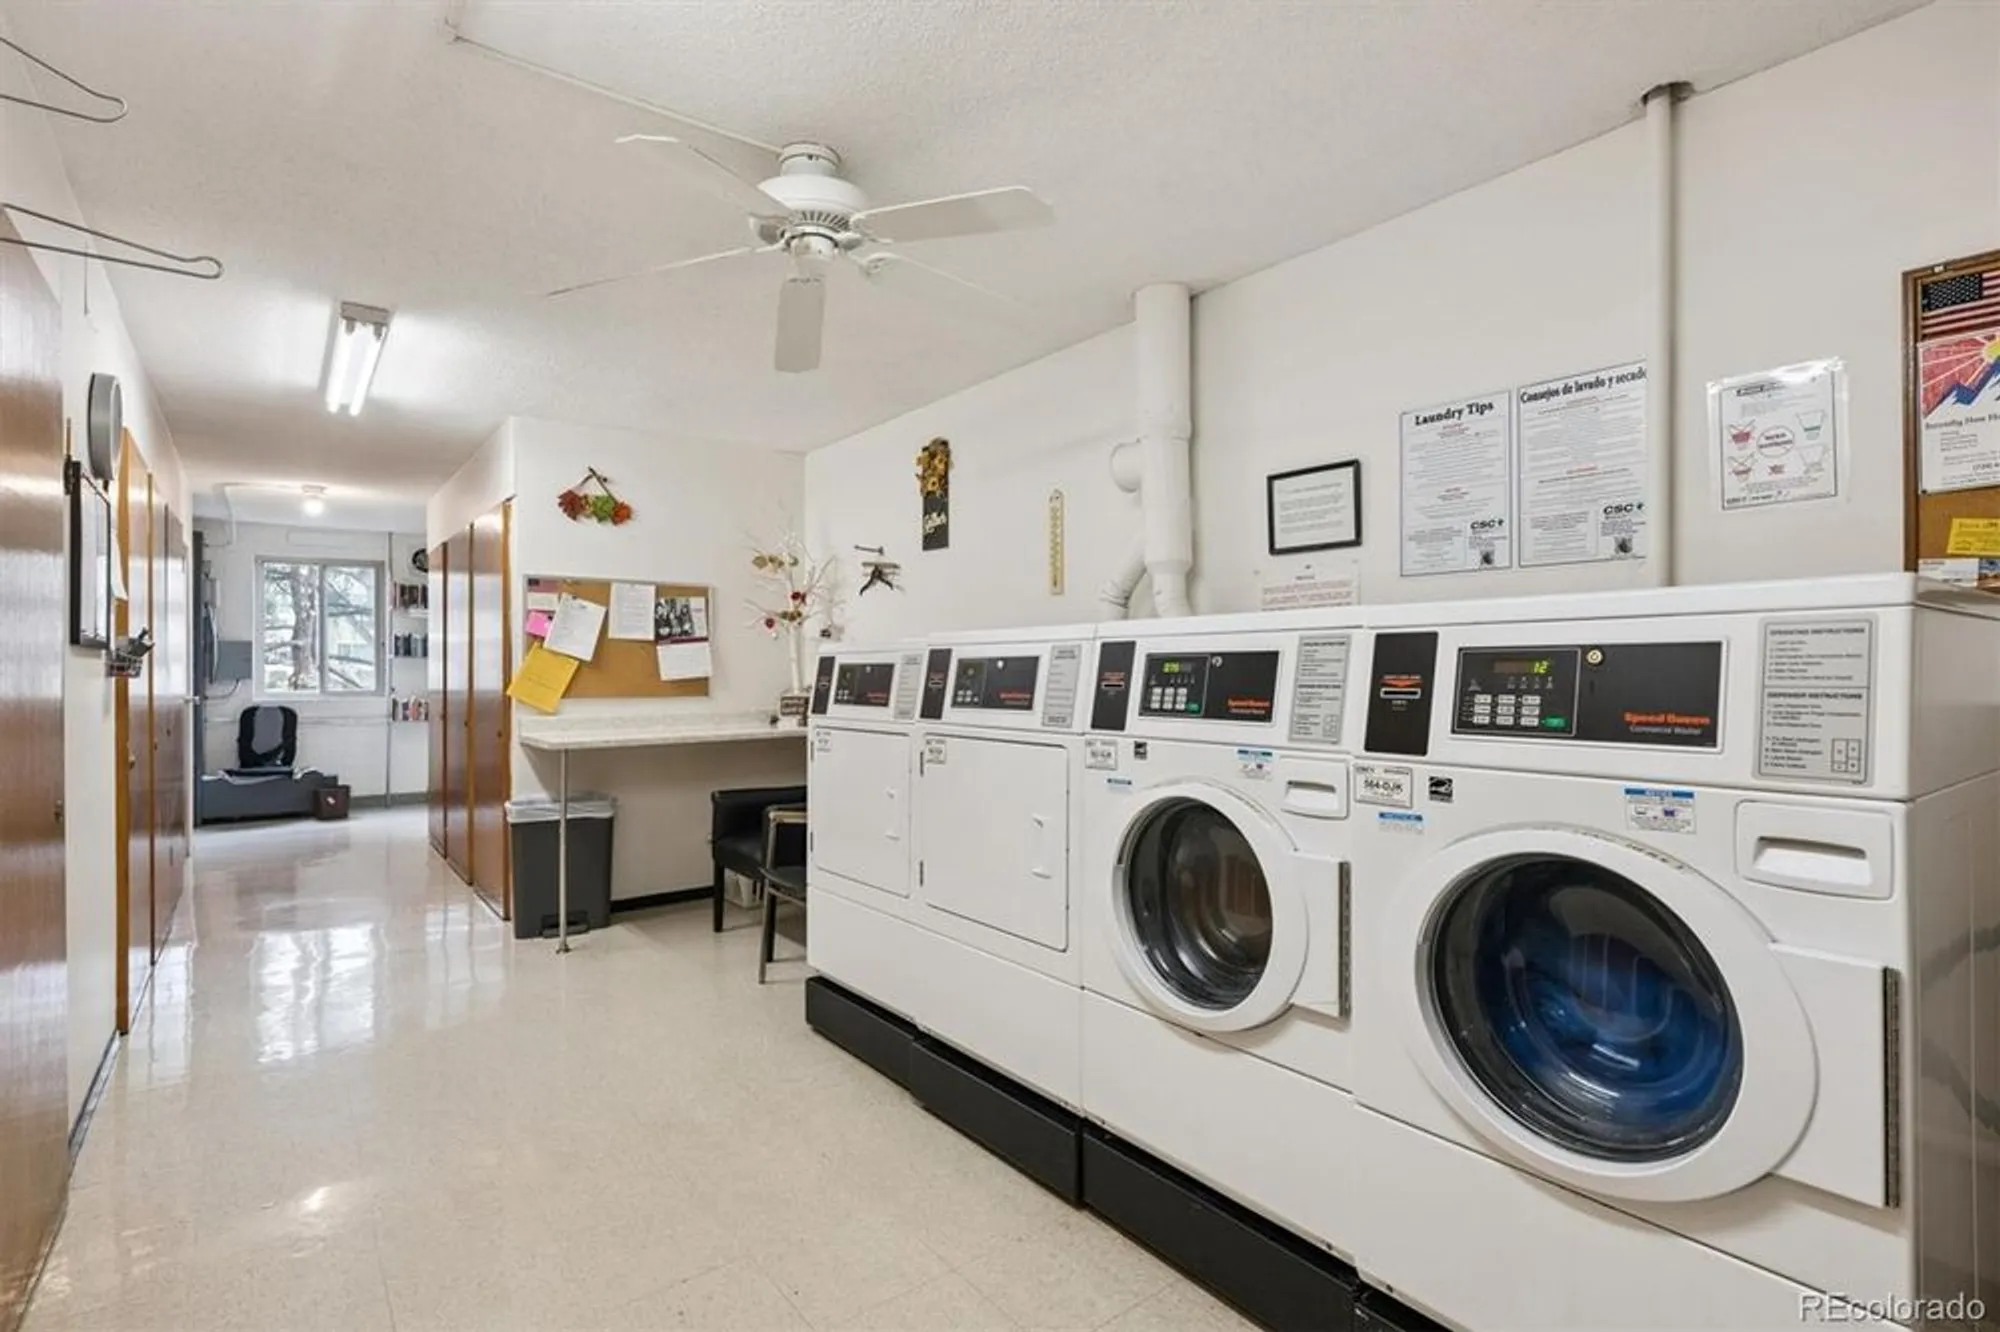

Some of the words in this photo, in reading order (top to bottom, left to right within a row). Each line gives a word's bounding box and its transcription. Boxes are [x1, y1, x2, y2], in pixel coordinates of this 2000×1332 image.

[1520, 388, 1560, 404] Consejos
[1562, 383, 1573, 396] de
[1574, 376, 1606, 393] lavado
[1415, 407, 1464, 426] Laundry
[1466, 402, 1494, 416] Tips
[1603, 502, 1632, 515] CSC
[1470, 519, 1496, 530] CSC
[1624, 712, 1665, 725] Speed
[1666, 713, 1710, 726] Queen
